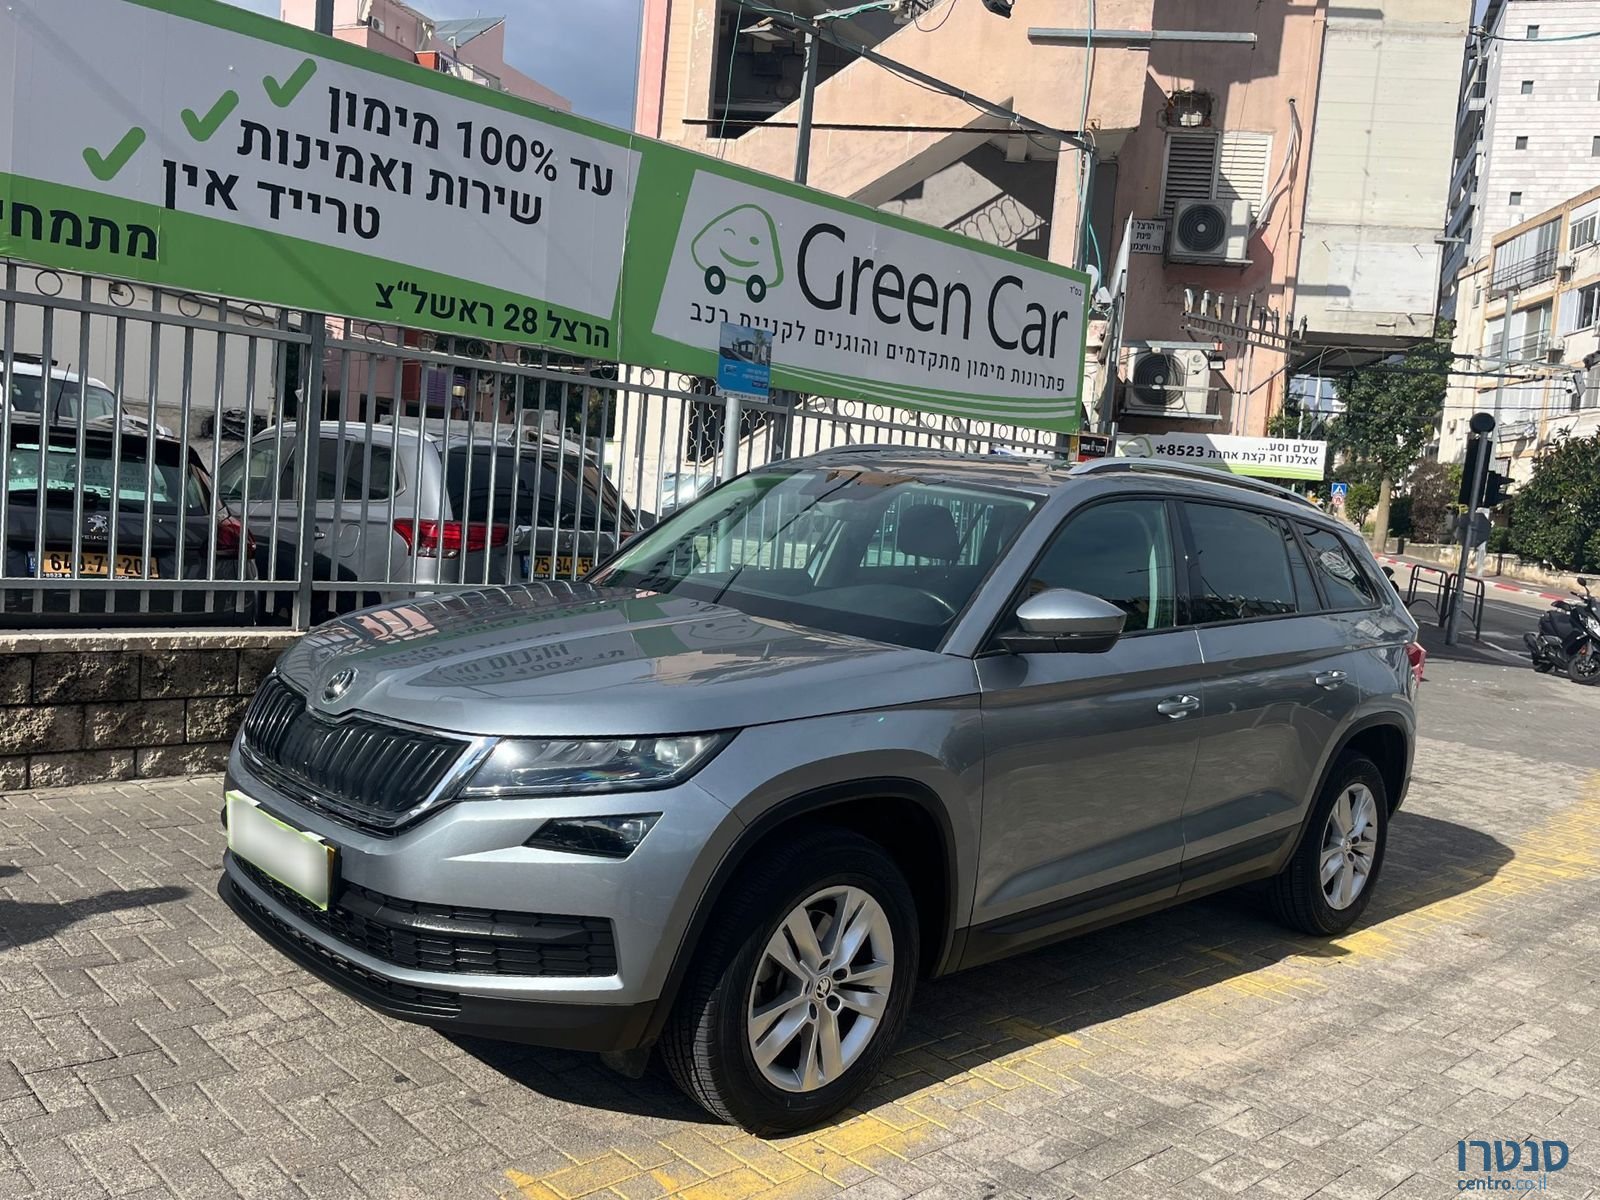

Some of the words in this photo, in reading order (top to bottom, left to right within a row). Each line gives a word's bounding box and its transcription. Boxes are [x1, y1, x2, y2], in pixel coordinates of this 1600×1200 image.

[329, 86, 439, 150] מימון
[237, 119, 412, 195] ואמינות
[457, 121, 557, 182] 100%
[163, 159, 239, 211] אין
[570, 157, 613, 196] עד
[257, 181, 380, 239] טרייד
[426, 168, 542, 225] שירות
[1136, 232, 1151, 240] פינת
[1137, 221, 1155, 230] הרצל
[797, 223, 971, 340] Green
[988, 275, 1069, 359] Car
[503, 303, 538, 334] 28
[690, 303, 728, 323] רכב
[547, 310, 609, 348] הרצל
[815, 329, 877, 356] והוגנים
[887, 344, 960, 372] מתקדמים
[967, 360, 1005, 381] מימון
[1011, 368, 1065, 392] פתרונות
[1207, 450, 1239, 460] אחרת
[1242, 452, 1266, 464] קצת
[1270, 453, 1282, 462] זה
[1286, 454, 1318, 465] אצלנו
[1293, 444, 1319, 454] שלם
